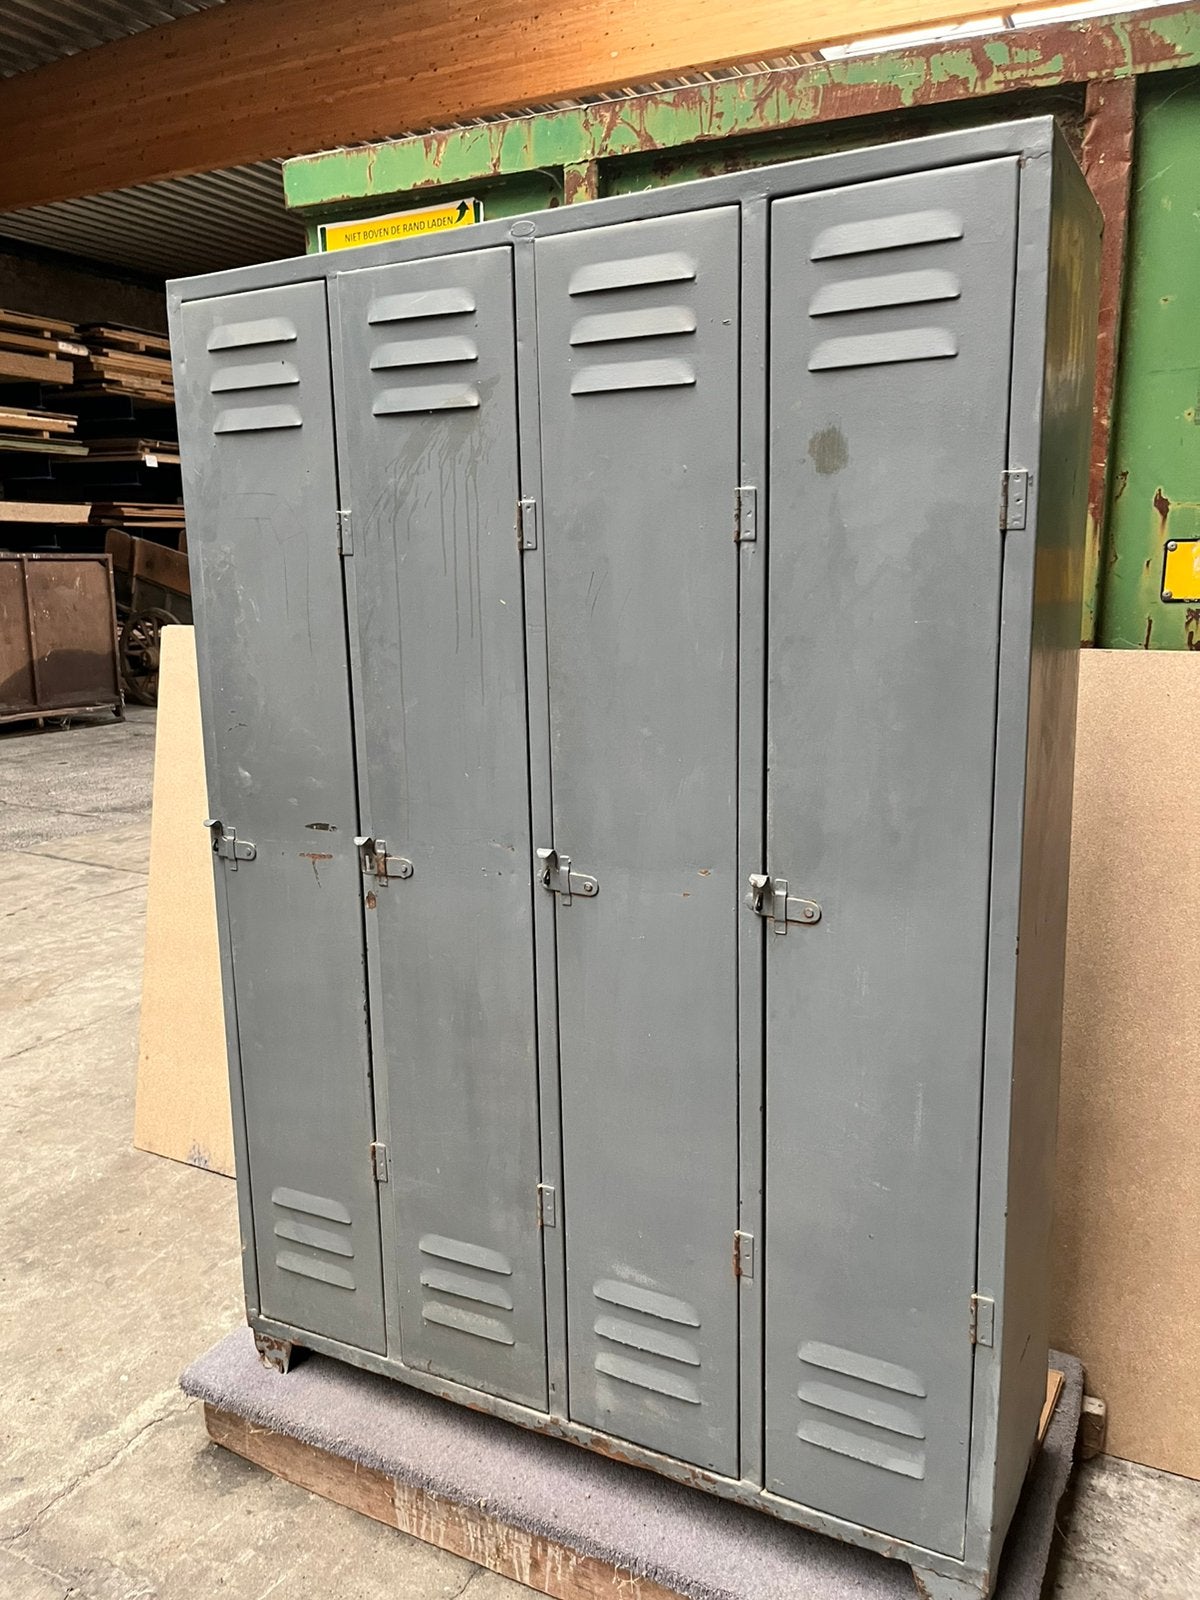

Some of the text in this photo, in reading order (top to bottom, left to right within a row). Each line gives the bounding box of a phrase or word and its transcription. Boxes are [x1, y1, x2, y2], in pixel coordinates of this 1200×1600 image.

[345, 216, 453, 242] NIET BOVEN DE RAND LADEN
